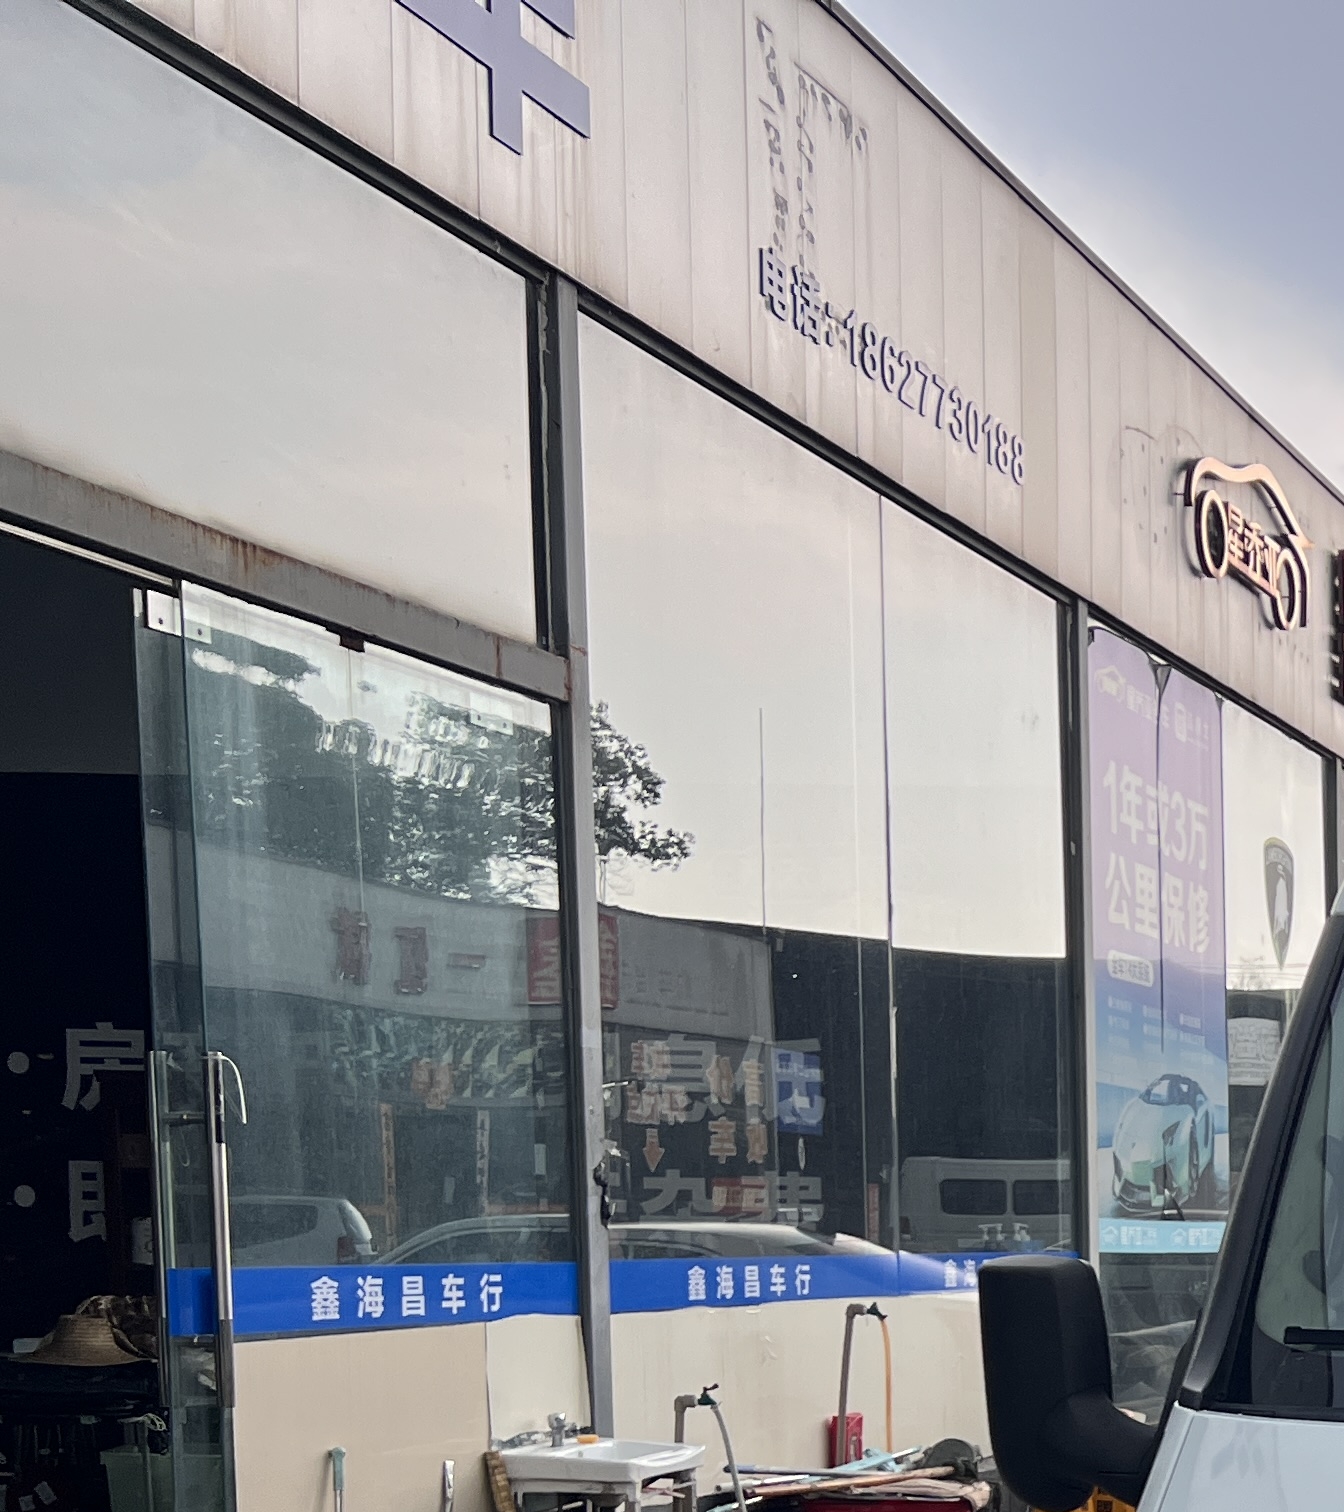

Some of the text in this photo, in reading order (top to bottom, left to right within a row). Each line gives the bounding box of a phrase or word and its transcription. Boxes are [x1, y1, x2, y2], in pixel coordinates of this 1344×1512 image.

[1104, 851, 1211, 954] 公里保修
[687, 1264, 811, 1301] 鑫海昌车行
[944, 1259, 985, 1288] 鑫海
[310, 1273, 503, 1321] 鑫海昌车行
